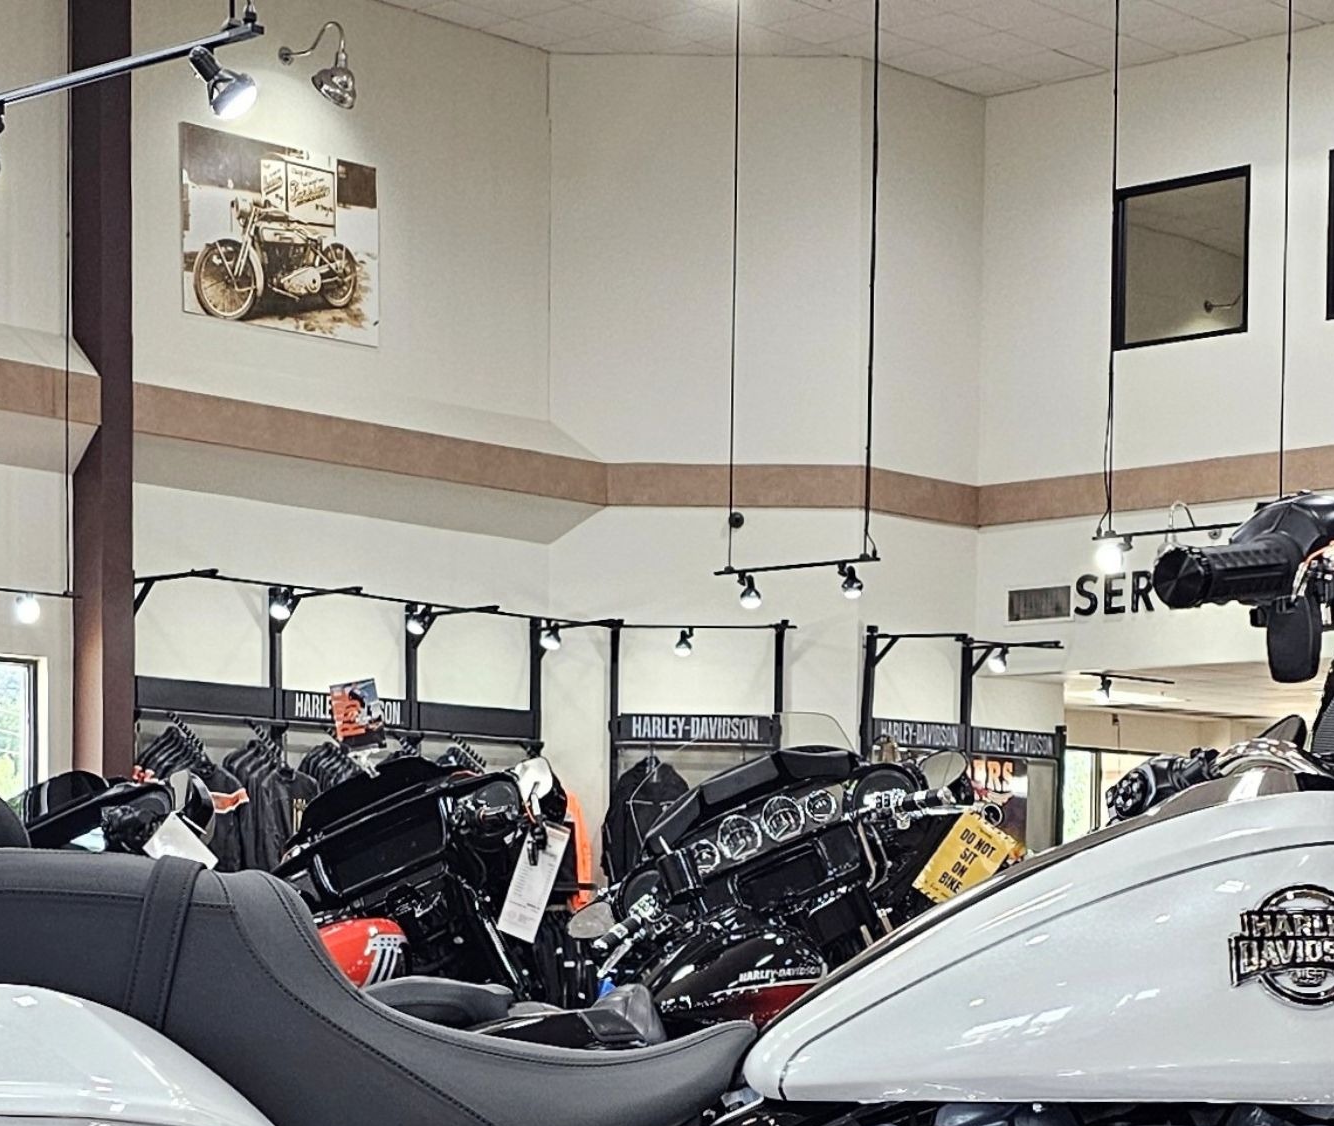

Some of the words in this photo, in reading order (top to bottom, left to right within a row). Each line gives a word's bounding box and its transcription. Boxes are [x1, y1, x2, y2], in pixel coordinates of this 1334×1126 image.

[632, 715, 759, 741] HARLEY-DAVIDSON
[879, 721, 959, 748] HARLEY-DAVIDSON
[979, 729, 1054, 756] HARLEY-DAVIDSON
[960, 828, 976, 845] DO
[974, 838, 996, 858] NOT
[951, 861, 969, 878] ON
[960, 848, 978, 865] SIT
[938, 871, 964, 894] BIKE
